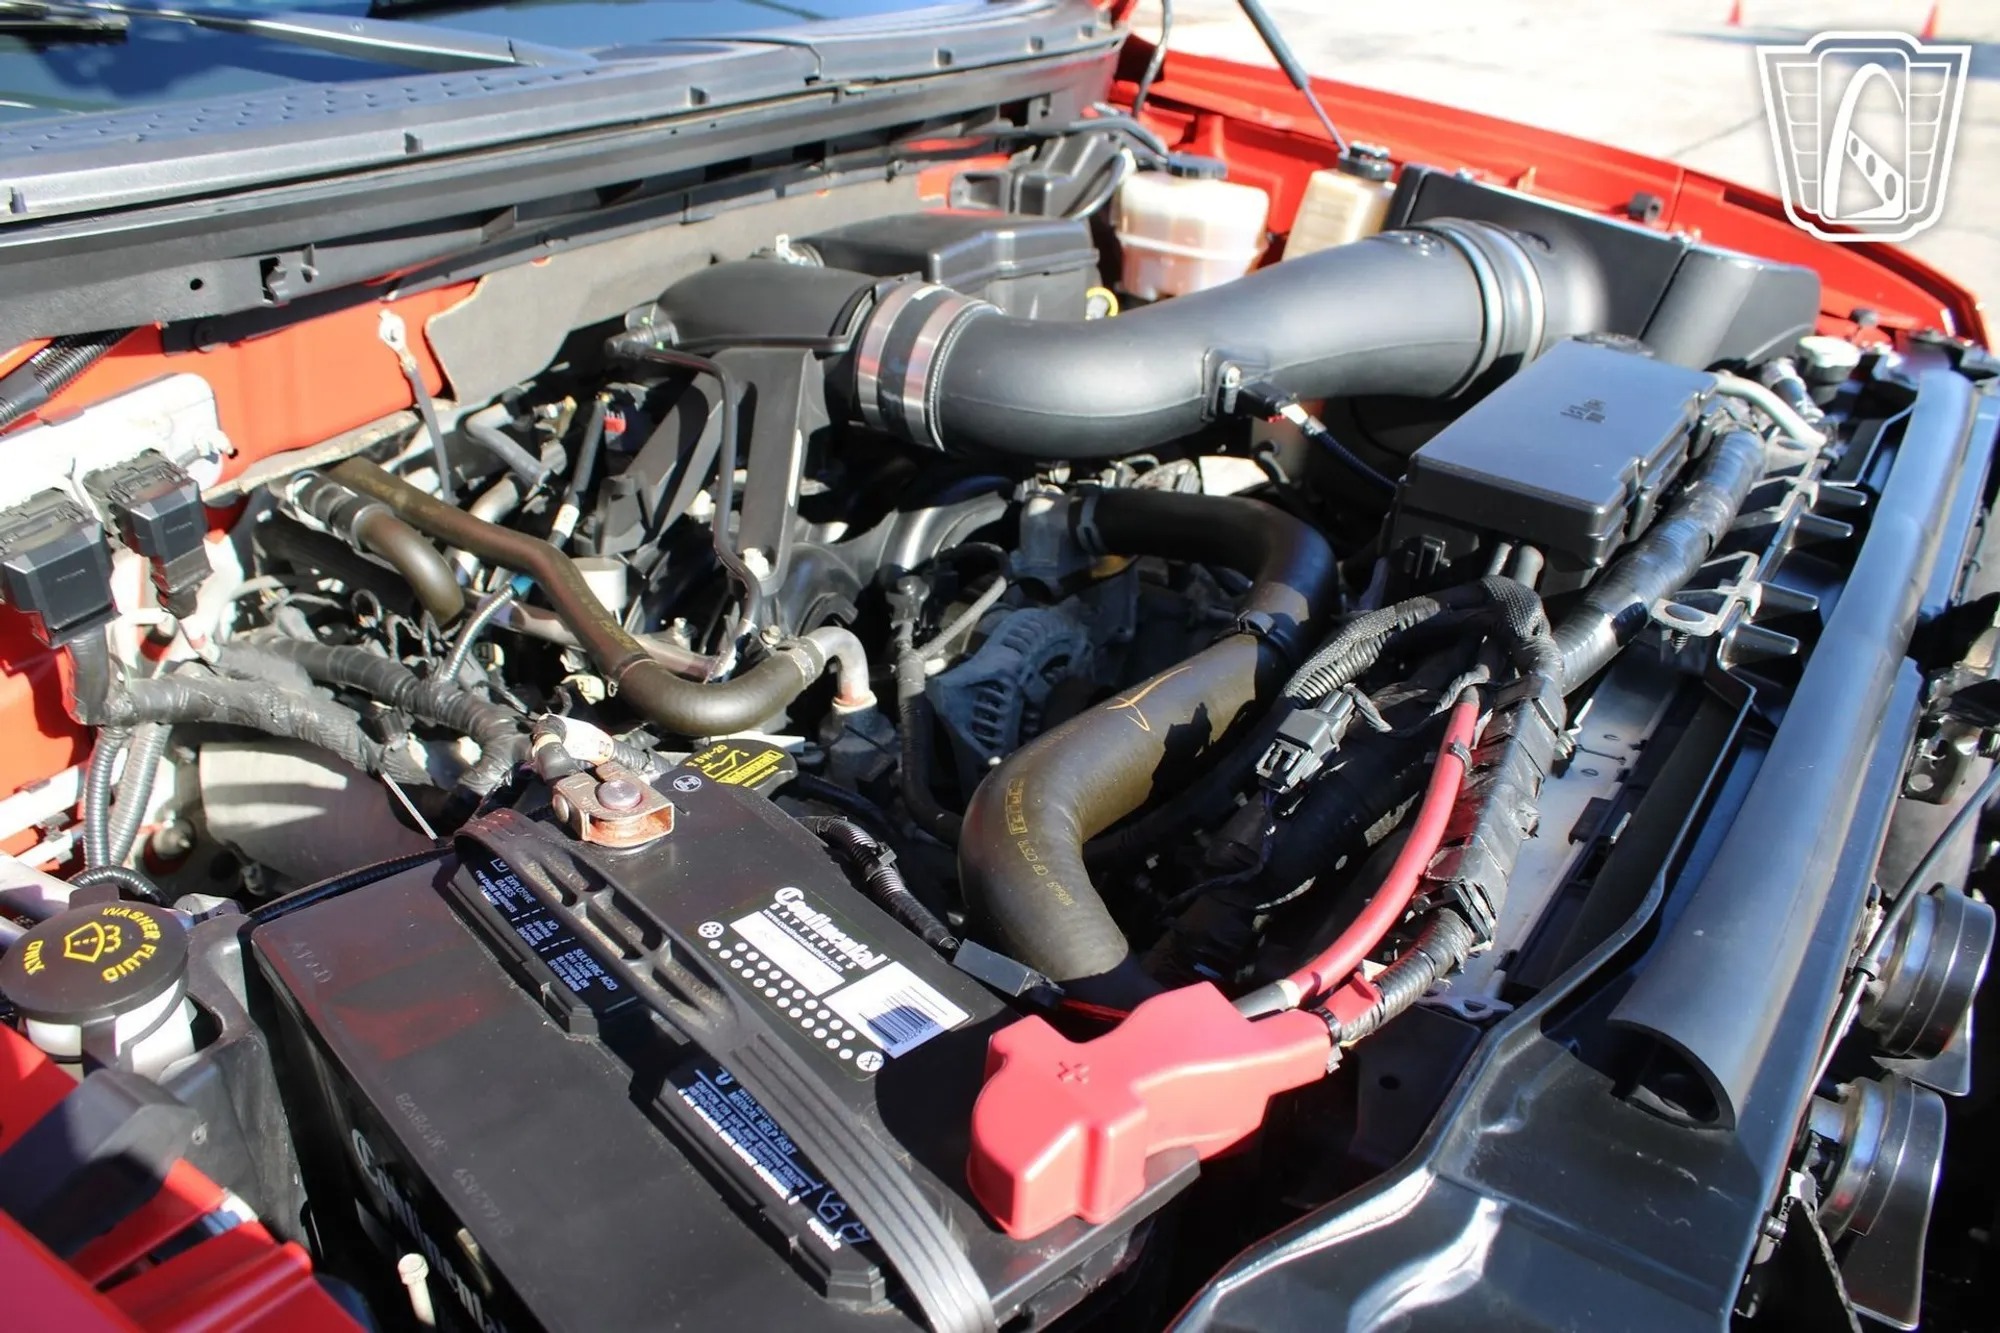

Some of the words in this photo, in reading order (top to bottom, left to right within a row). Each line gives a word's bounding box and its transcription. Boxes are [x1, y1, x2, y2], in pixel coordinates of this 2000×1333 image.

[494, 879, 516, 897] GASES
[102, 907, 161, 940] WASHER
[544, 920, 559, 930] NO
[769, 903, 857, 969] BATTERIES
[775, 887, 887, 970] Continental
[24, 940, 46, 976] ONLY
[102, 943, 157, 983] FLUID
[564, 952, 577, 962] CAN
[573, 961, 593, 978] CAUSE
[572, 948, 605, 976] SULFURIC
[599, 975, 620, 992] ACID
[727, 1091, 760, 1120] MEDICAL
[756, 1119, 779, 1138] HELP
[774, 1136, 797, 1155] FAST
